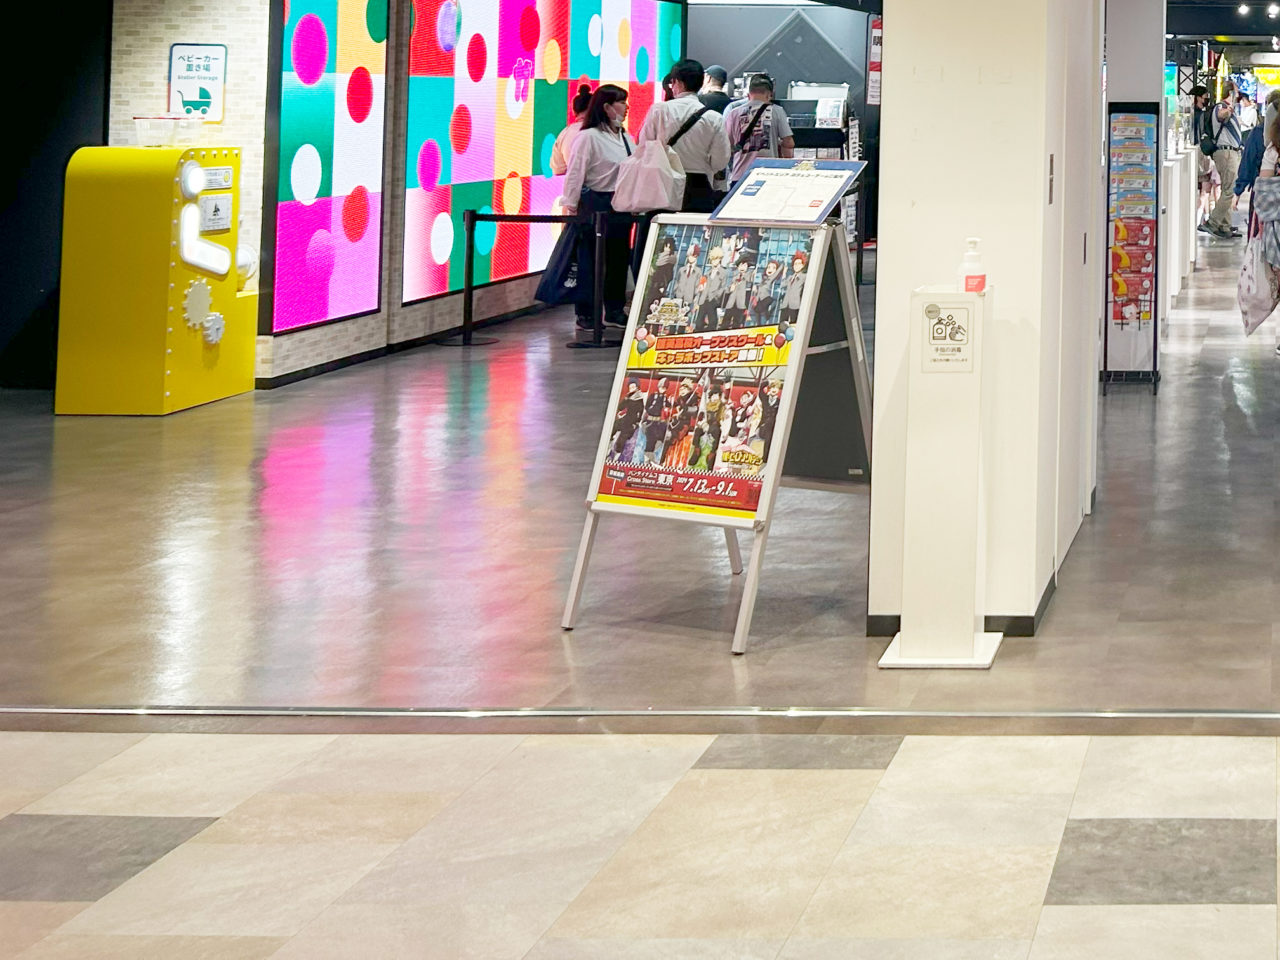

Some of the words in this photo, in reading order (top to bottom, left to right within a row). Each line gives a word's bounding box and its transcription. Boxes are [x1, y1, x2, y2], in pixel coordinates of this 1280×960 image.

[178, 55, 220, 63] ベビーカー
[186, 63, 211, 72] 置き場
[656, 473, 675, 486] 東京
